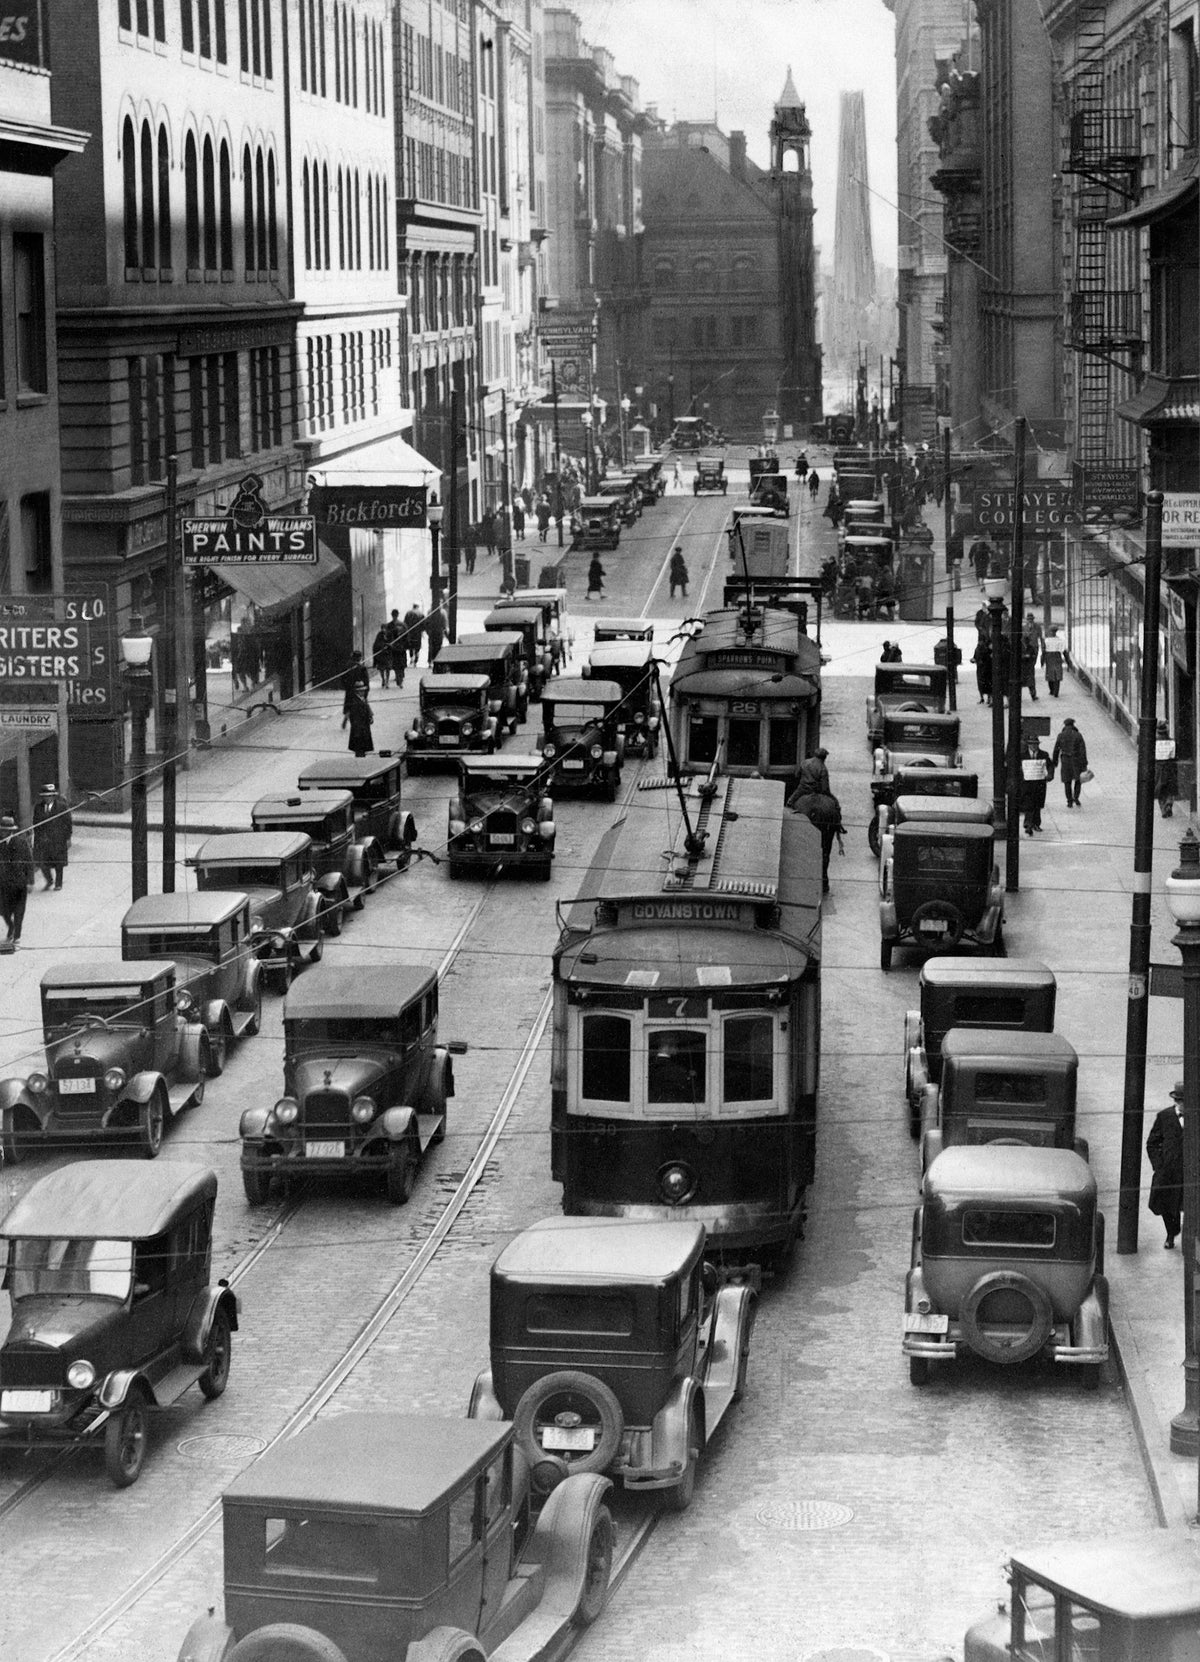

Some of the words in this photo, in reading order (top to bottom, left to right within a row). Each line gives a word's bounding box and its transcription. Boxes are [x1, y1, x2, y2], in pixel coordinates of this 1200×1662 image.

[326, 497, 423, 525] Bickford's
[1162, 510, 1180, 524] OR
[185, 521, 228, 533] SHERWIN
[267, 519, 313, 532] WILLIAMS
[192, 532, 306, 553] PAINTS
[199, 555, 219, 563] RIGHT
[283, 553, 313, 561] SURFACE
[732, 702, 757, 714] 26
[0, 714, 51, 724] LAUNDRY
[634, 904, 739, 919] GOVANSTOWN
[667, 997, 689, 1016] 7
